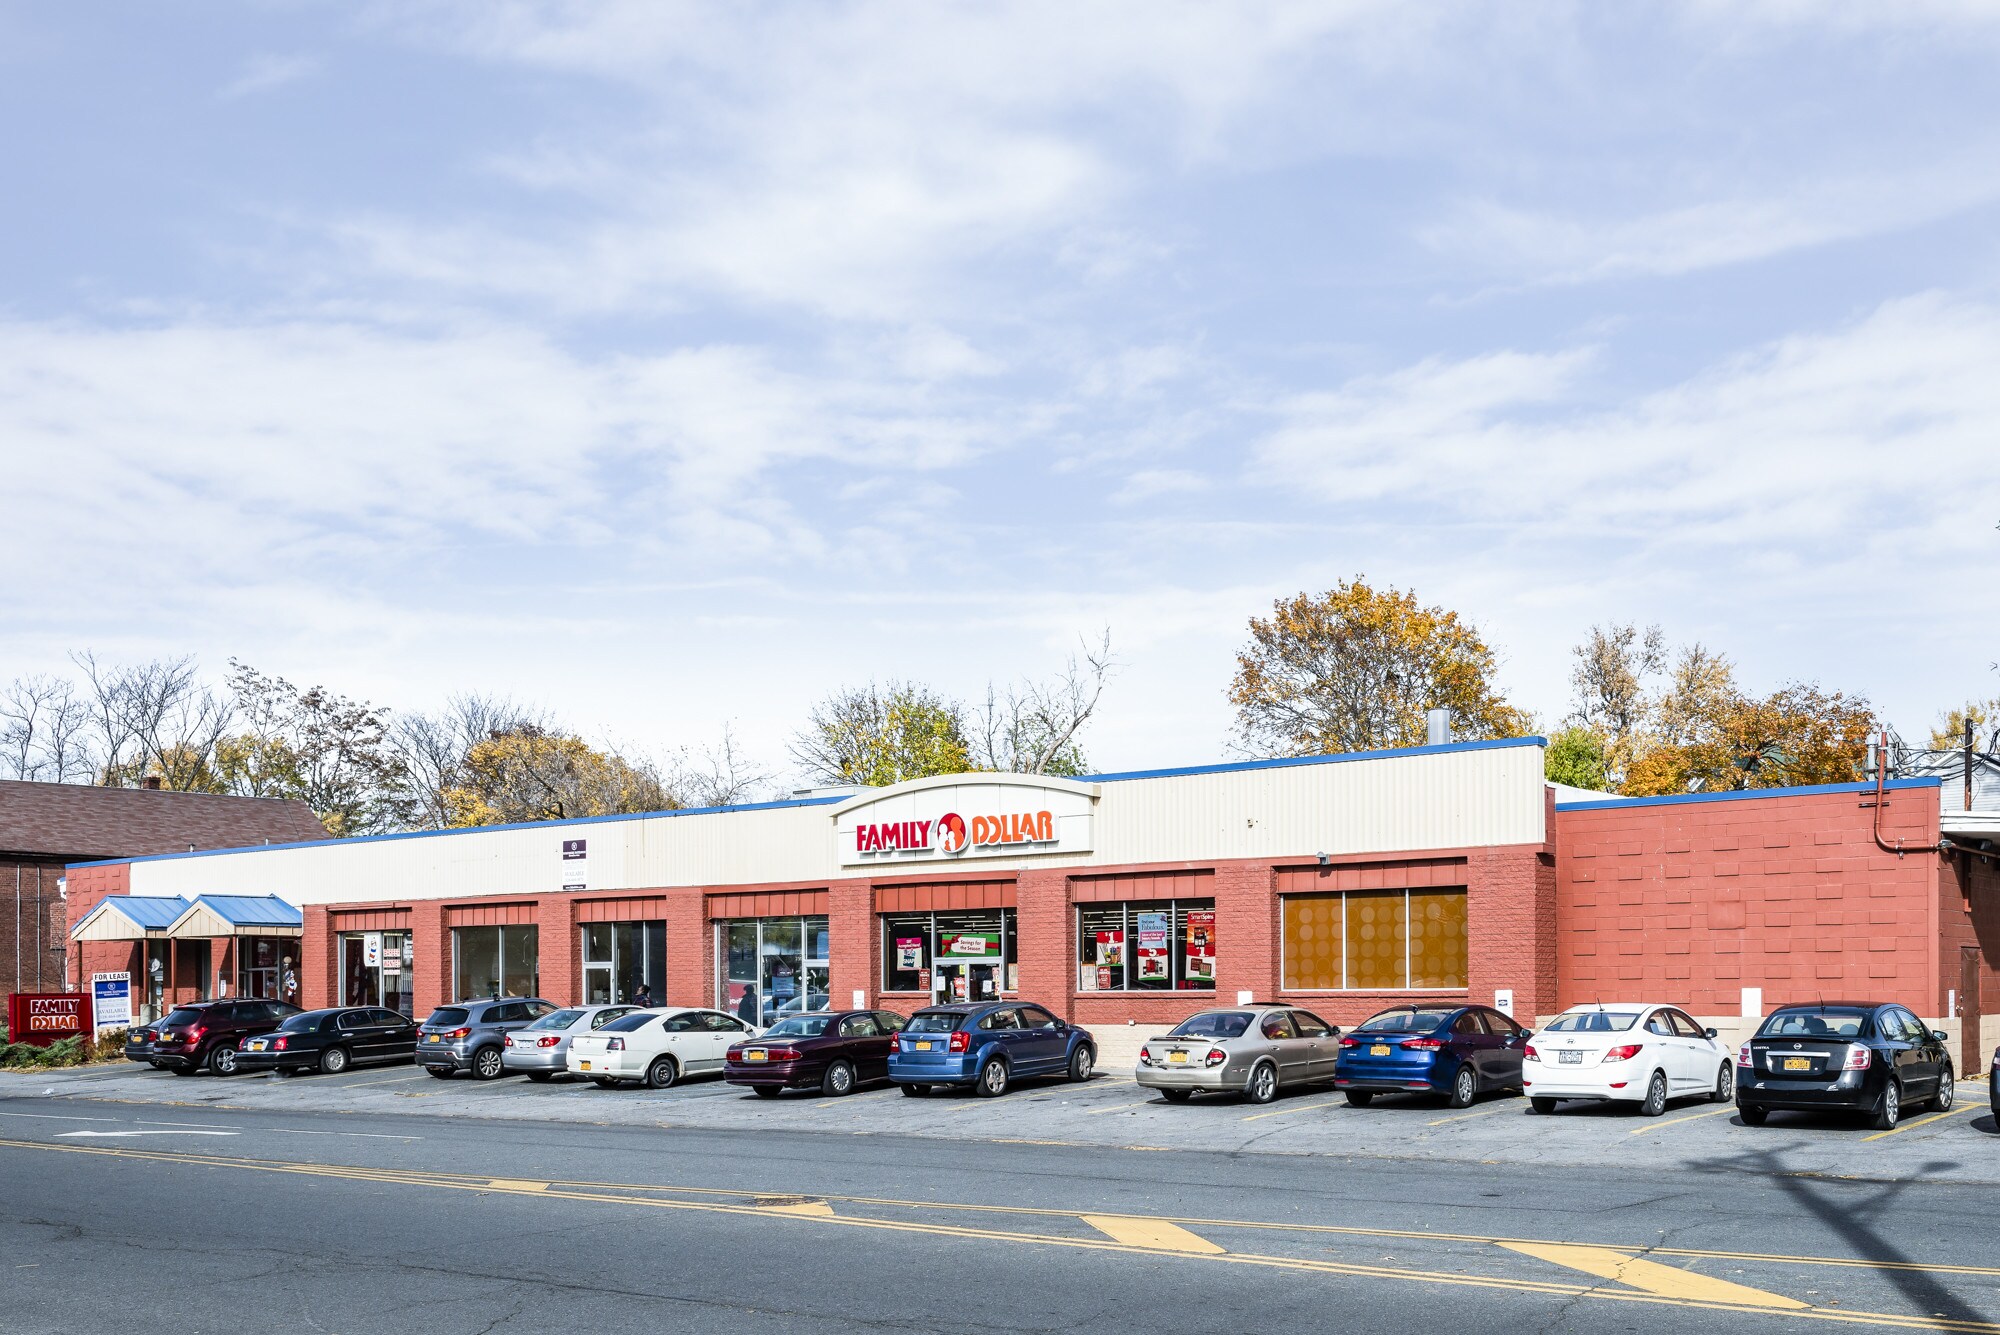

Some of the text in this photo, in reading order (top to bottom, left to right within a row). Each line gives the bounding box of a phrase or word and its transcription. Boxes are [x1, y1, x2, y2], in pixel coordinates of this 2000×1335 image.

[857, 810, 1053, 851] FAMILY DOLLAR
[94, 972, 129, 981] FOR LEASE
[30, 999, 80, 1014] FAMILY
[30, 1014, 80, 1030] DOLLAR
